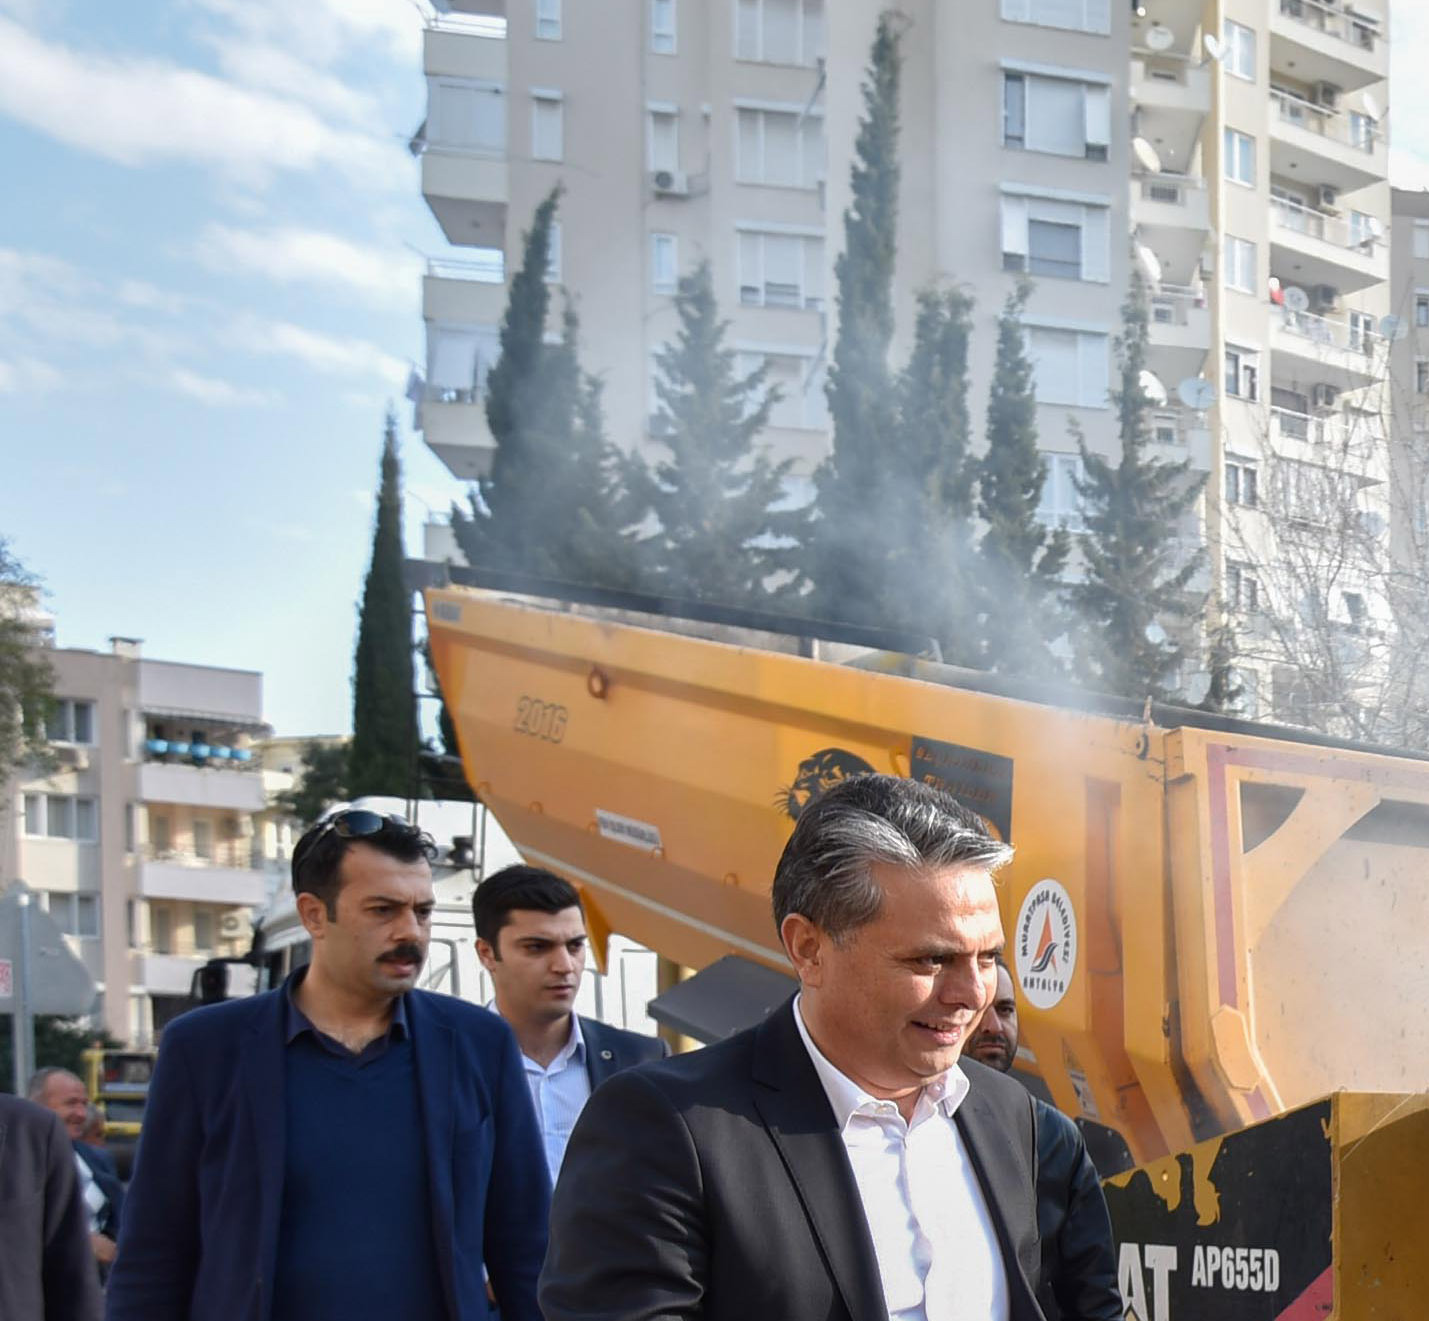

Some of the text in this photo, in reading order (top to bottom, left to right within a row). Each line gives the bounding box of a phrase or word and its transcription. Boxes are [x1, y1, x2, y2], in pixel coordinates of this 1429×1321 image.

[514, 695, 568, 744] 2016
[1023, 976, 1064, 993] ANTALYA
[1191, 1245, 1280, 1292] AP655D
